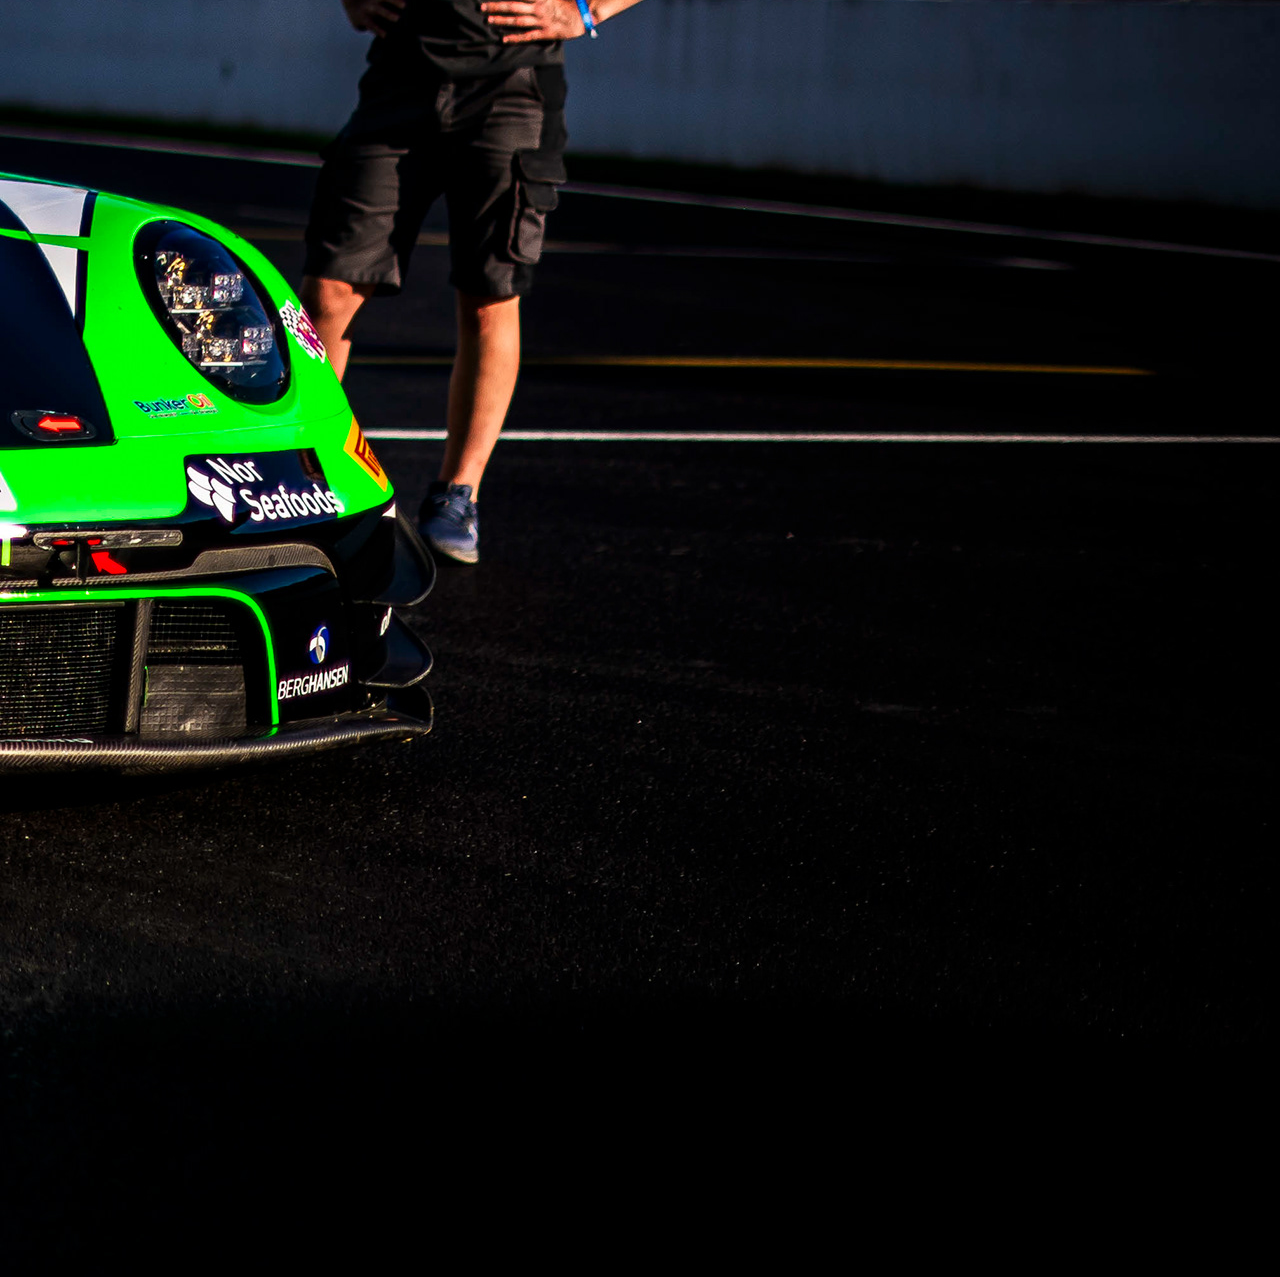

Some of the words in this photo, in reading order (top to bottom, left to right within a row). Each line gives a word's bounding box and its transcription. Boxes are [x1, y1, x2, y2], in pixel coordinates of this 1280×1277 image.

[133, 398, 189, 413] Bunker
[205, 457, 264, 486] Nor
[239, 483, 345, 523] Seafoods
[277, 664, 350, 701] BERGHANSEN
